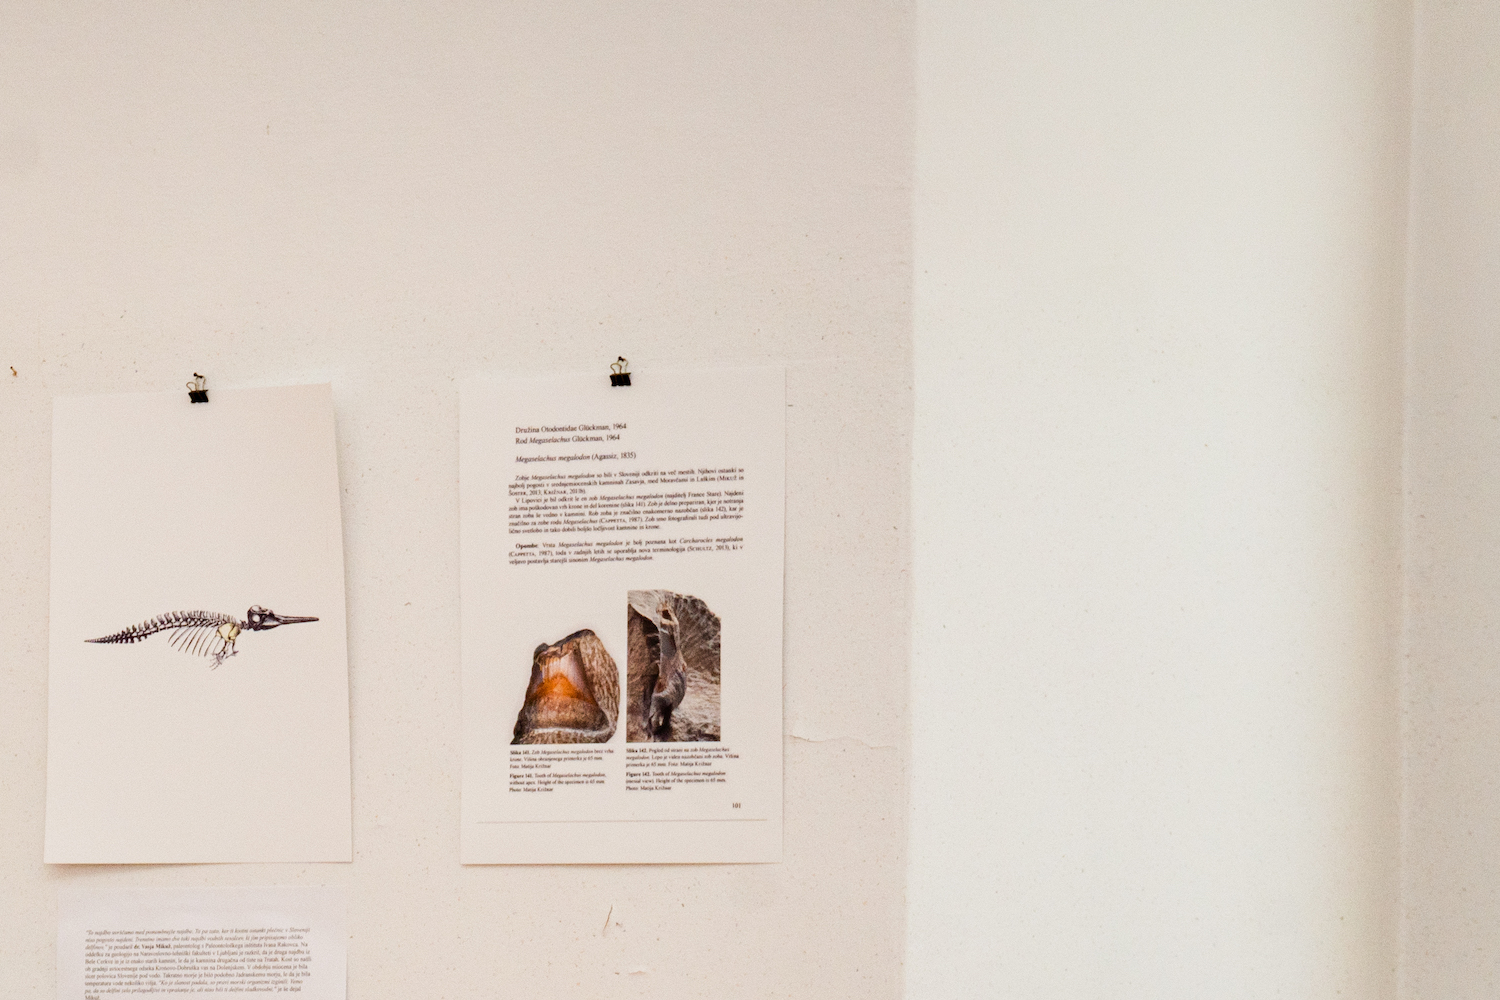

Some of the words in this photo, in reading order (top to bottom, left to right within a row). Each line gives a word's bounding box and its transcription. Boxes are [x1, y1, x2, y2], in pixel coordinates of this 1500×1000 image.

[516, 425, 540, 433] Družina
[541, 424, 577, 432] Otodontidae
[613, 422, 627, 430] 1964
[529, 435, 570, 446] Megaselachus
[606, 433, 621, 441] 1964
[516, 454, 556, 464] Megaselachus
[558, 453, 590, 463] megalodon
[621, 451, 637, 461] 1835)
